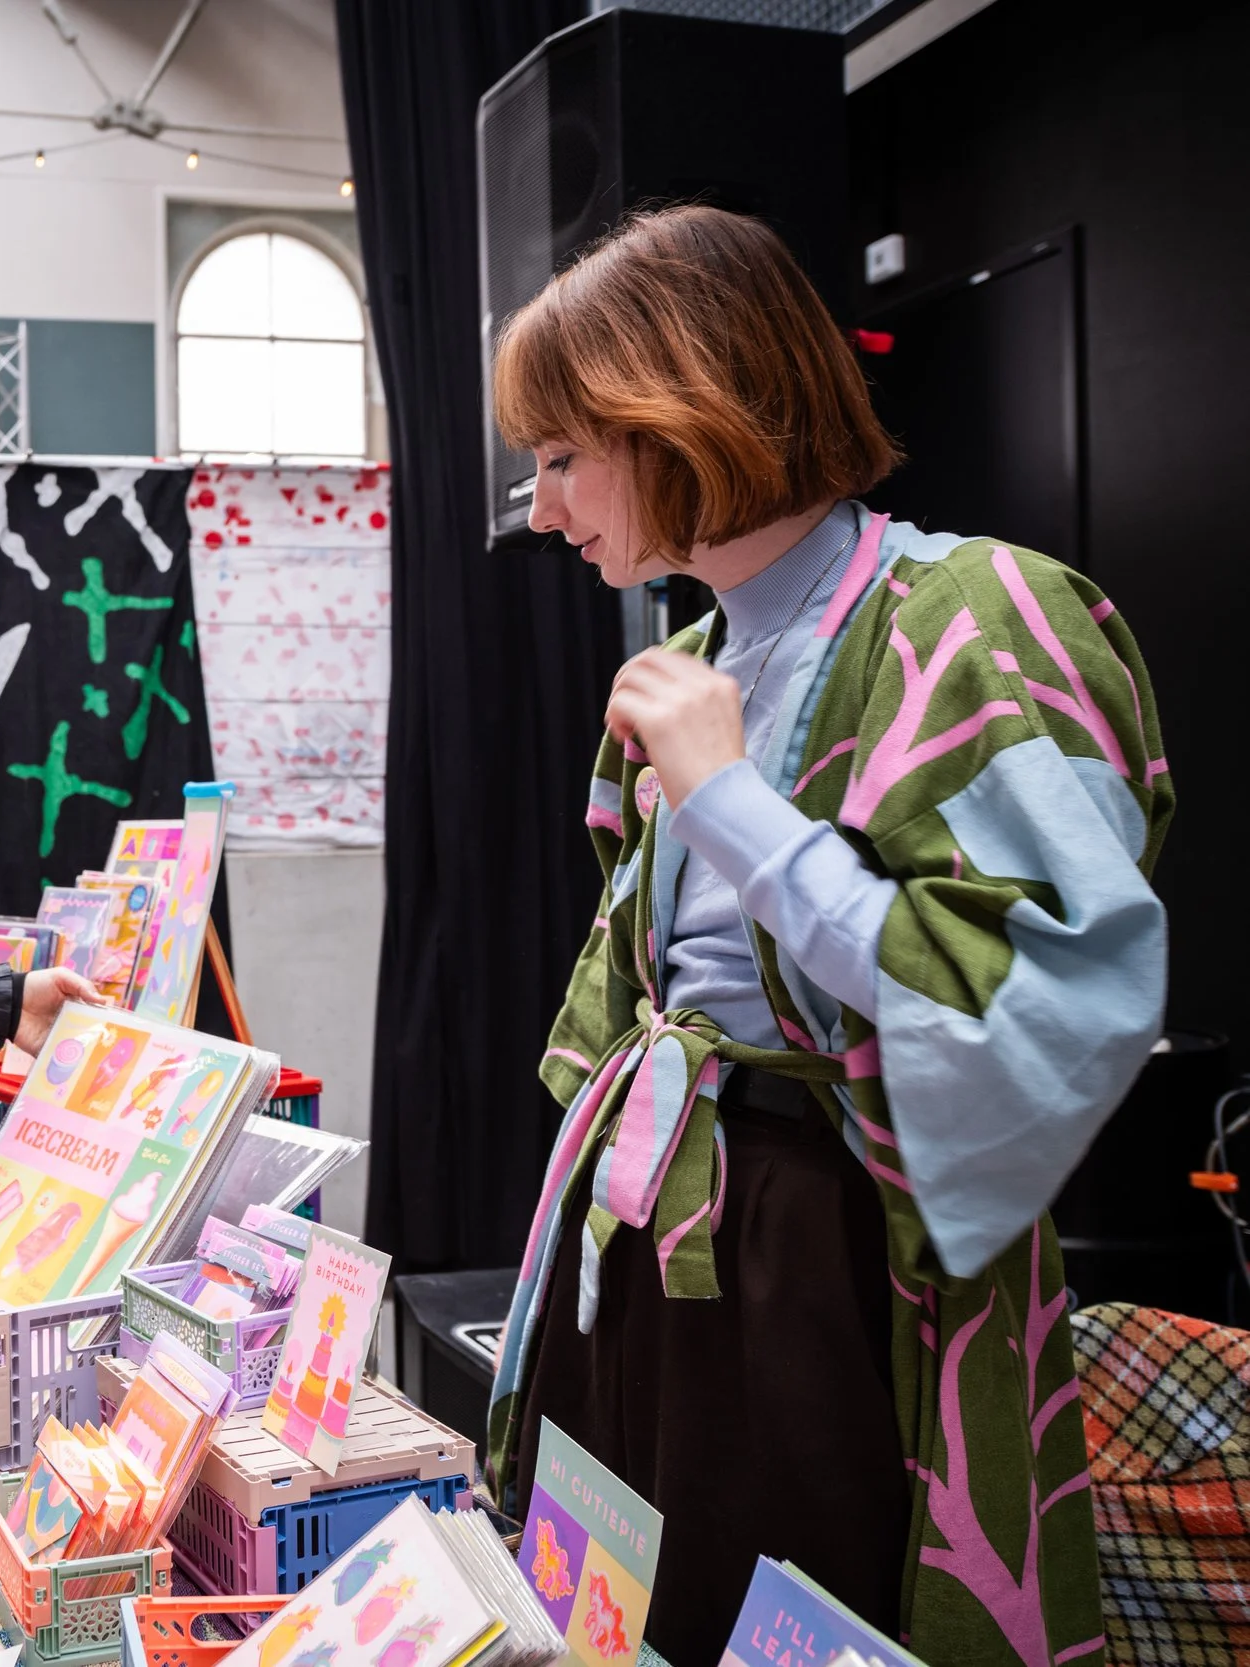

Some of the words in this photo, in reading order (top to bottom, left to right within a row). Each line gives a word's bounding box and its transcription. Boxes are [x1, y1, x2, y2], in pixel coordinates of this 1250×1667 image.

[14, 1118, 121, 1177] ICECREAM
[268, 1221, 297, 1240] STICKER
[223, 1249, 251, 1267] STICKER
[251, 1261, 266, 1273] SET
[328, 1255, 360, 1277] HAPPY
[315, 1265, 366, 1298] BIRTHDAY!
[550, 1456, 566, 1484] HI
[571, 1475, 647, 1558] CUTIEPIE
[774, 1609, 816, 1659] I'LL
